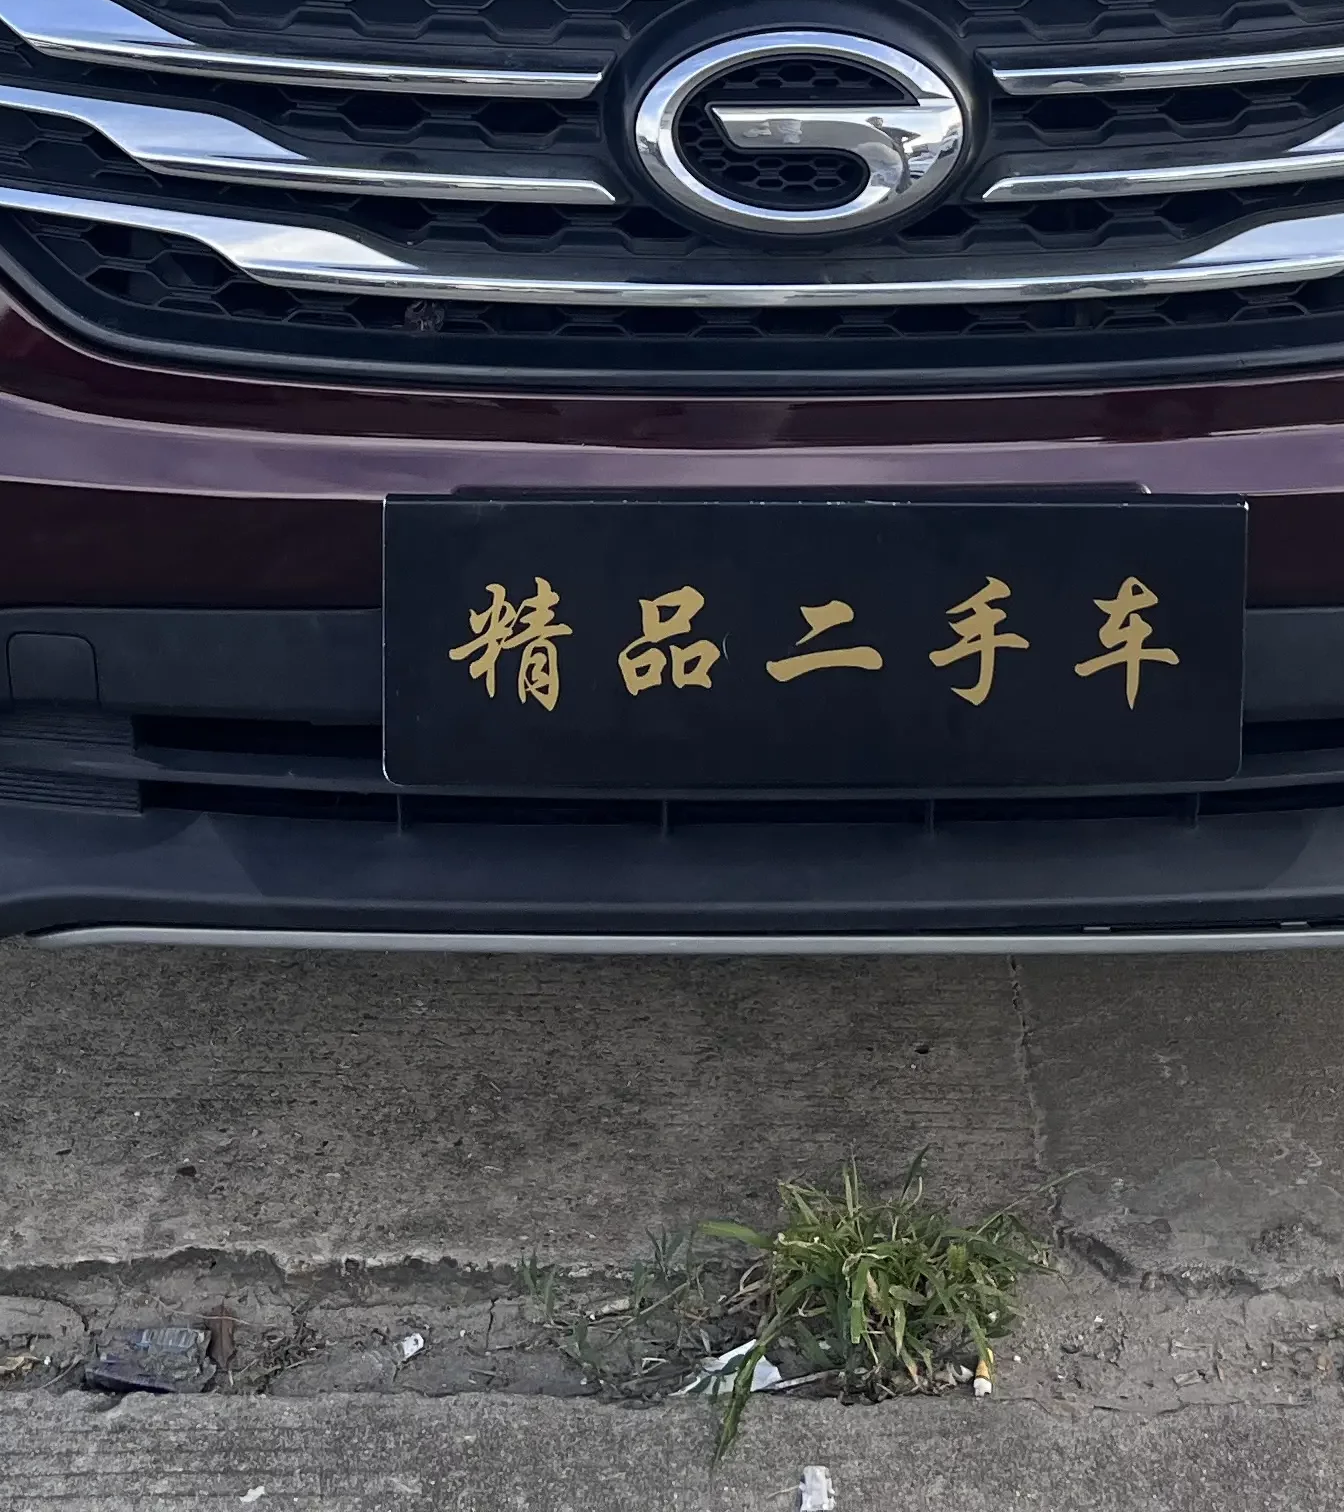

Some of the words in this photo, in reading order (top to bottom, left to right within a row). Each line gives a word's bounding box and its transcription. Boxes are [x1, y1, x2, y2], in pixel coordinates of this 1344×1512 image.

[449, 575, 1180, 711] 精品二手车
